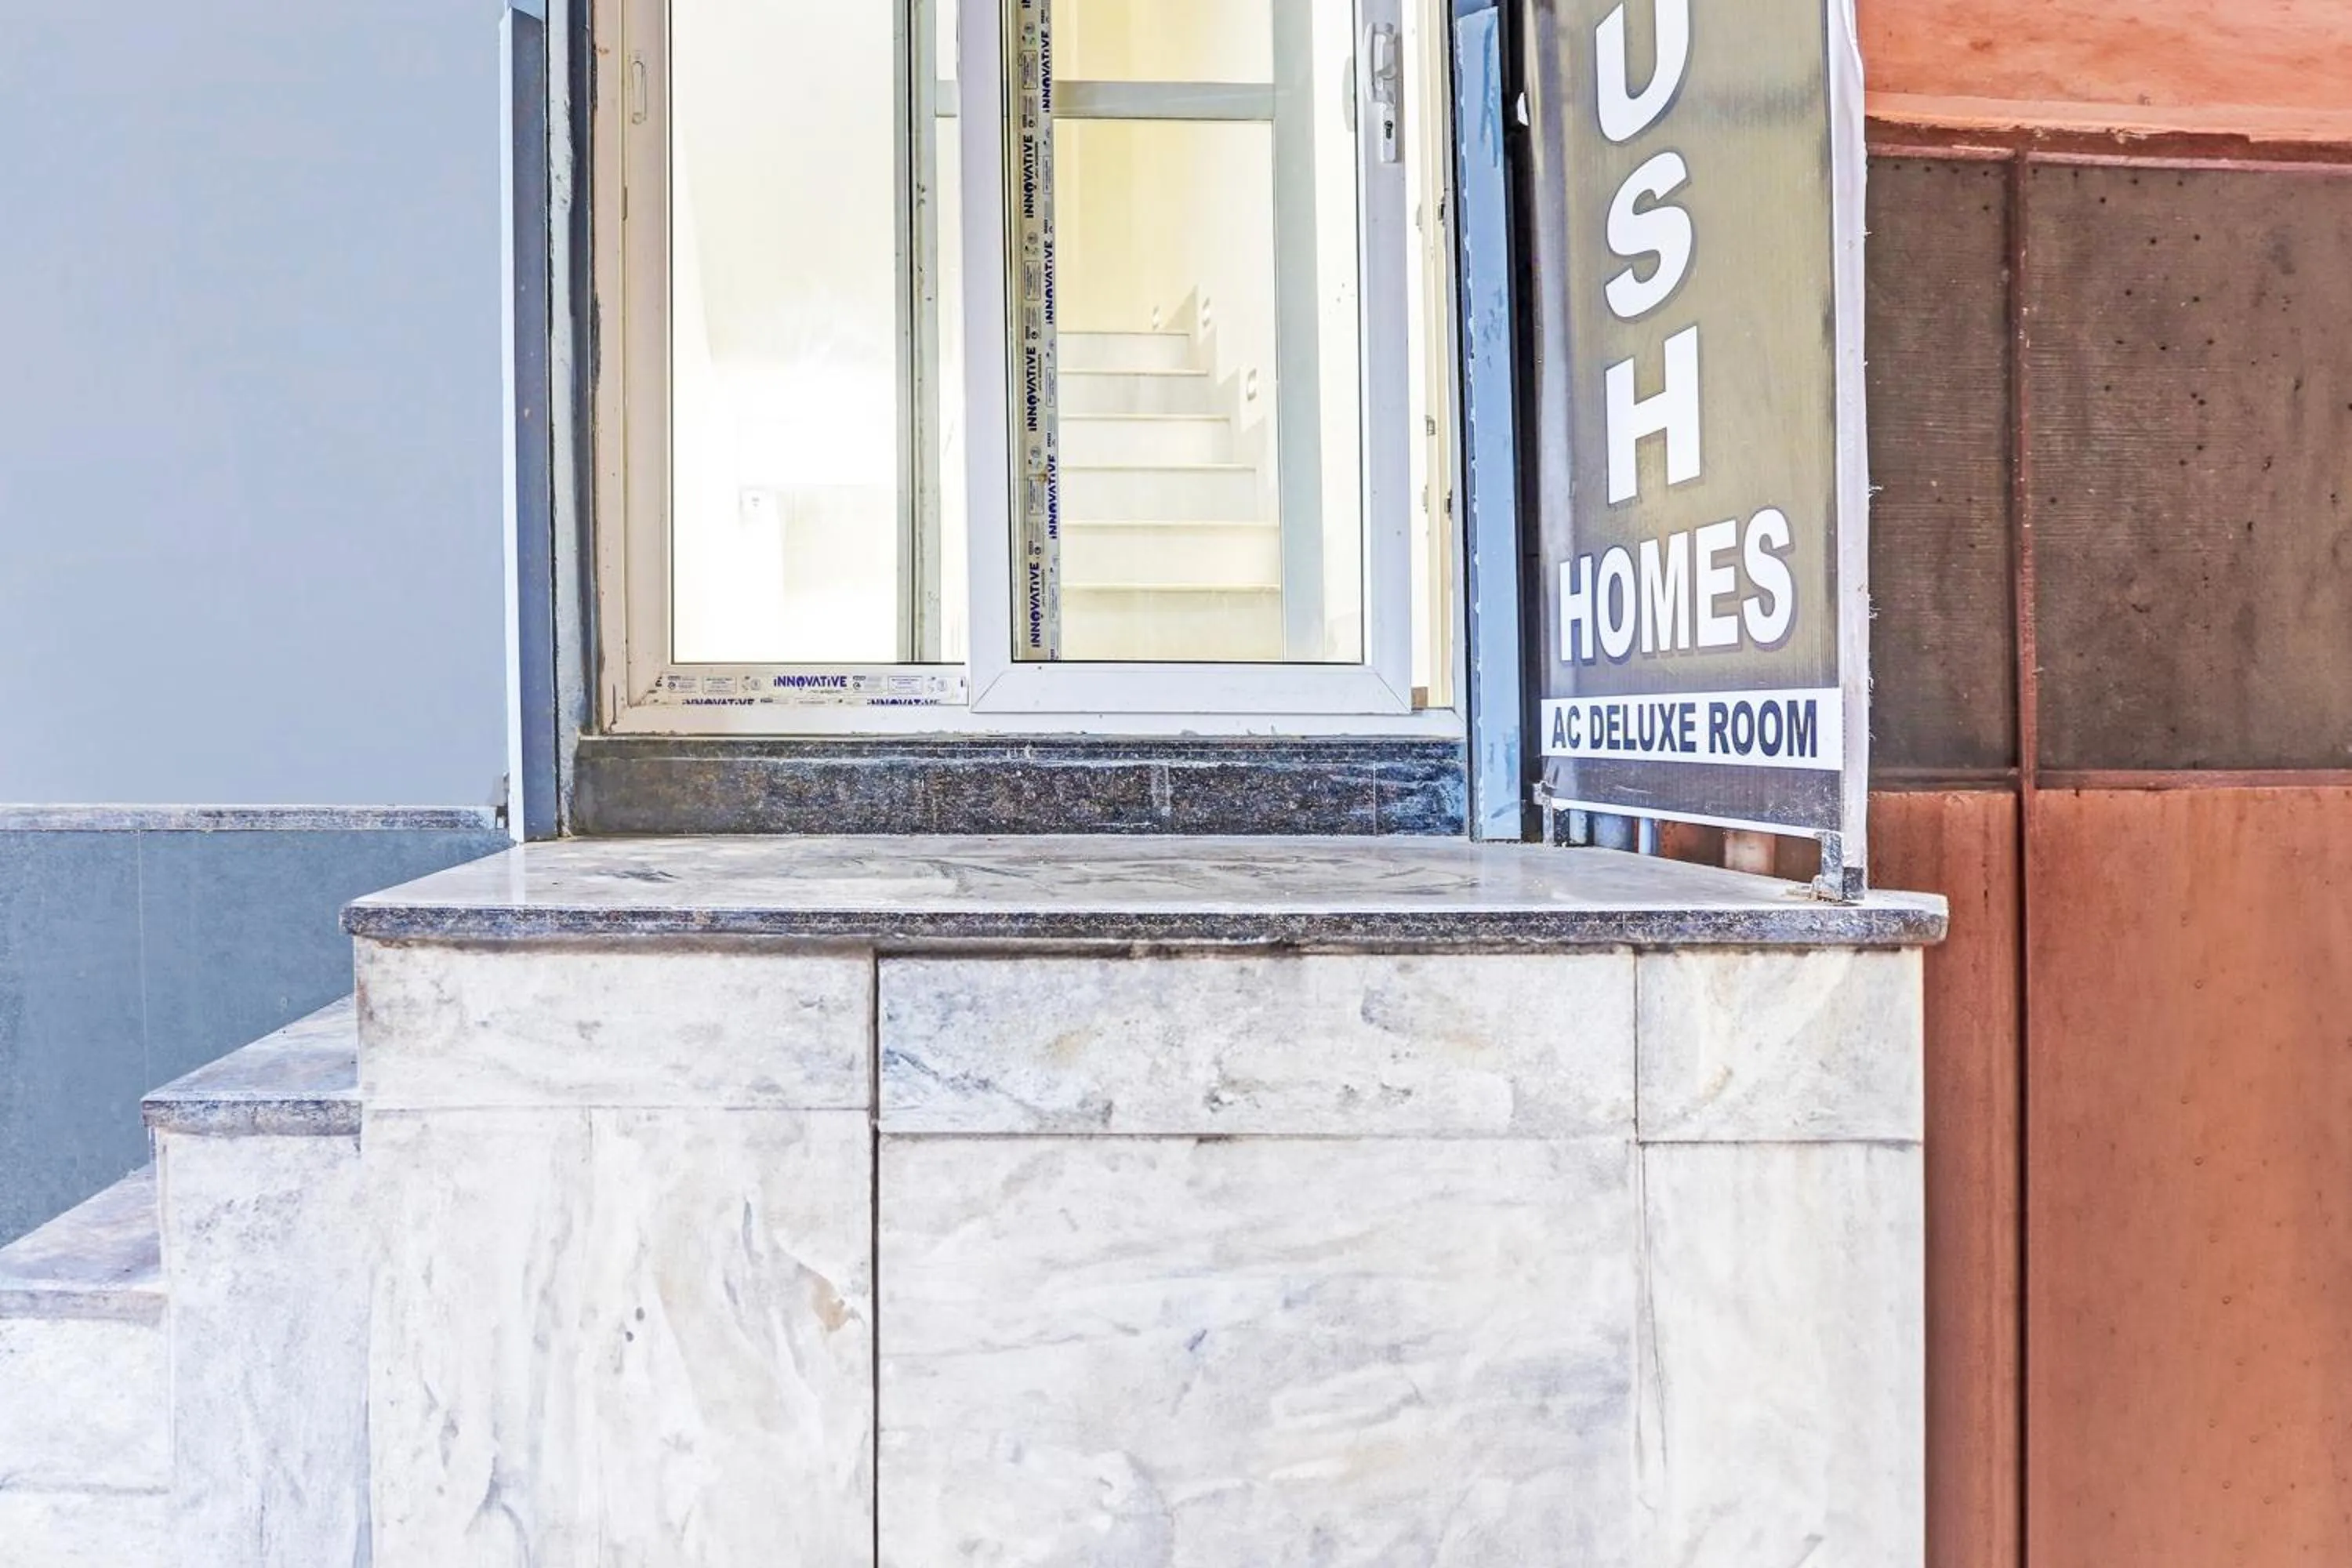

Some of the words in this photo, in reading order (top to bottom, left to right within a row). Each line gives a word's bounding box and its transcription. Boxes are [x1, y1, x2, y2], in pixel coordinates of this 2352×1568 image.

[1559, 508, 1794, 662] HOMES
[1552, 706, 1581, 750] AC
[1589, 702, 1697, 753] DELUXE
[1708, 699, 1817, 758] ROOM
